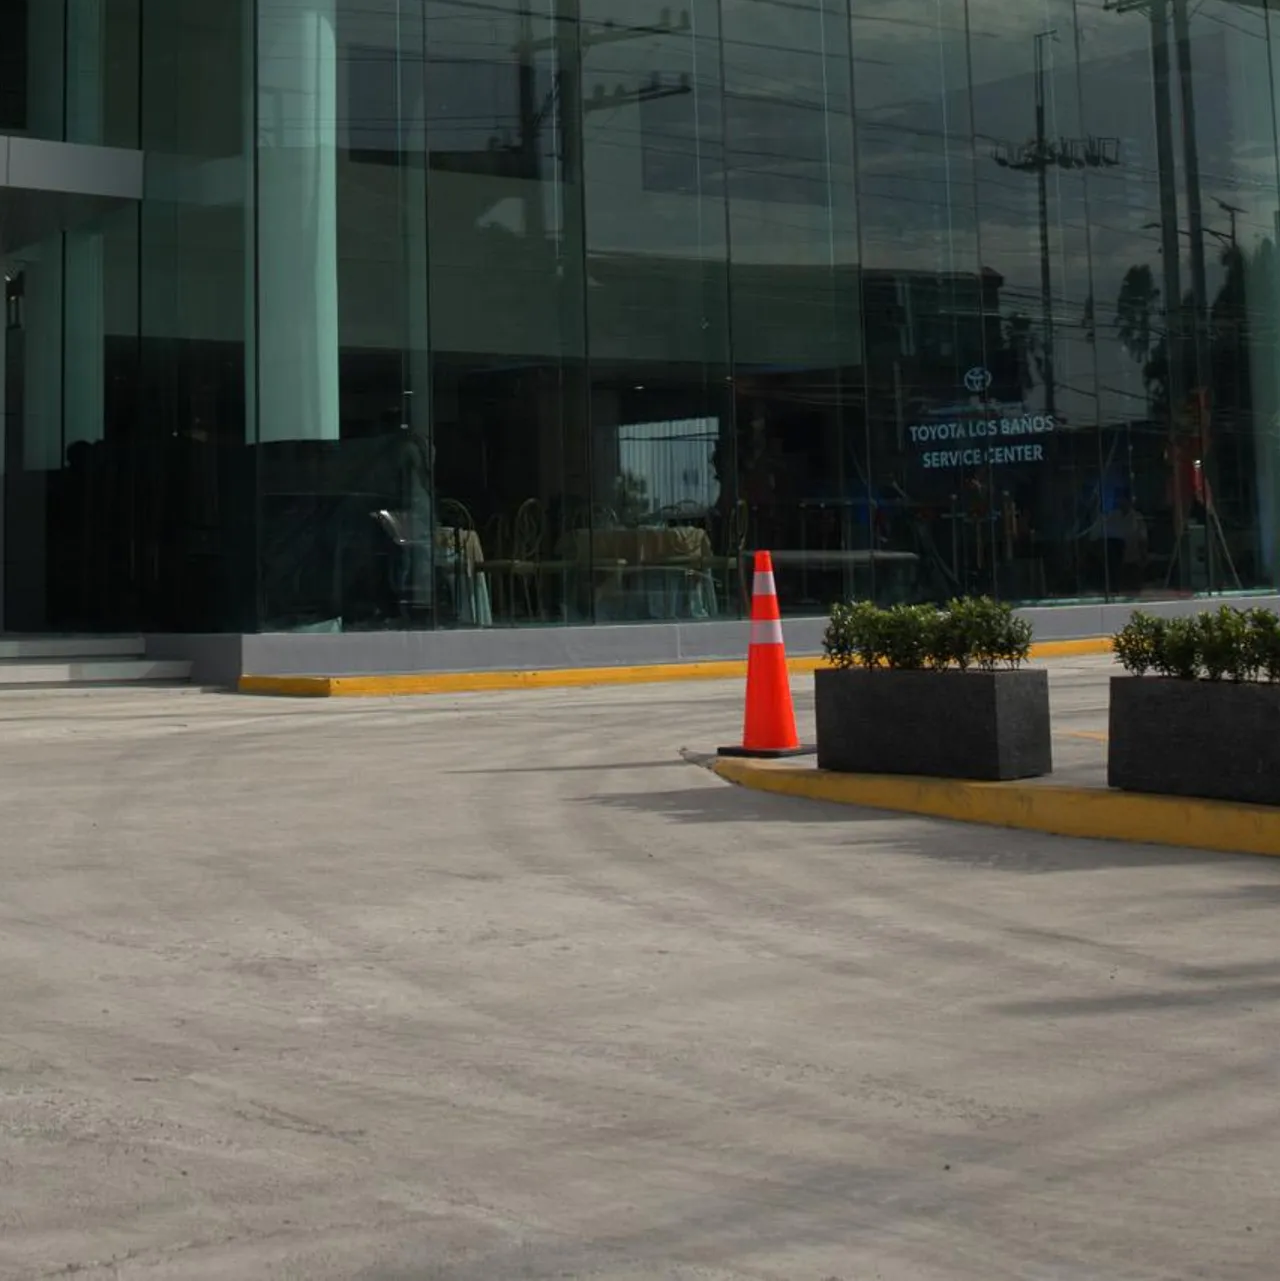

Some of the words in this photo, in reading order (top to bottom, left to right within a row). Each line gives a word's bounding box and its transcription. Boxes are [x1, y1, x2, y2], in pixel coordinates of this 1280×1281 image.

[909, 422, 967, 442] TOYOTA
[968, 419, 998, 437] LOS
[922, 448, 981, 469] SERVICE
[984, 444, 1043, 464] CENTER
